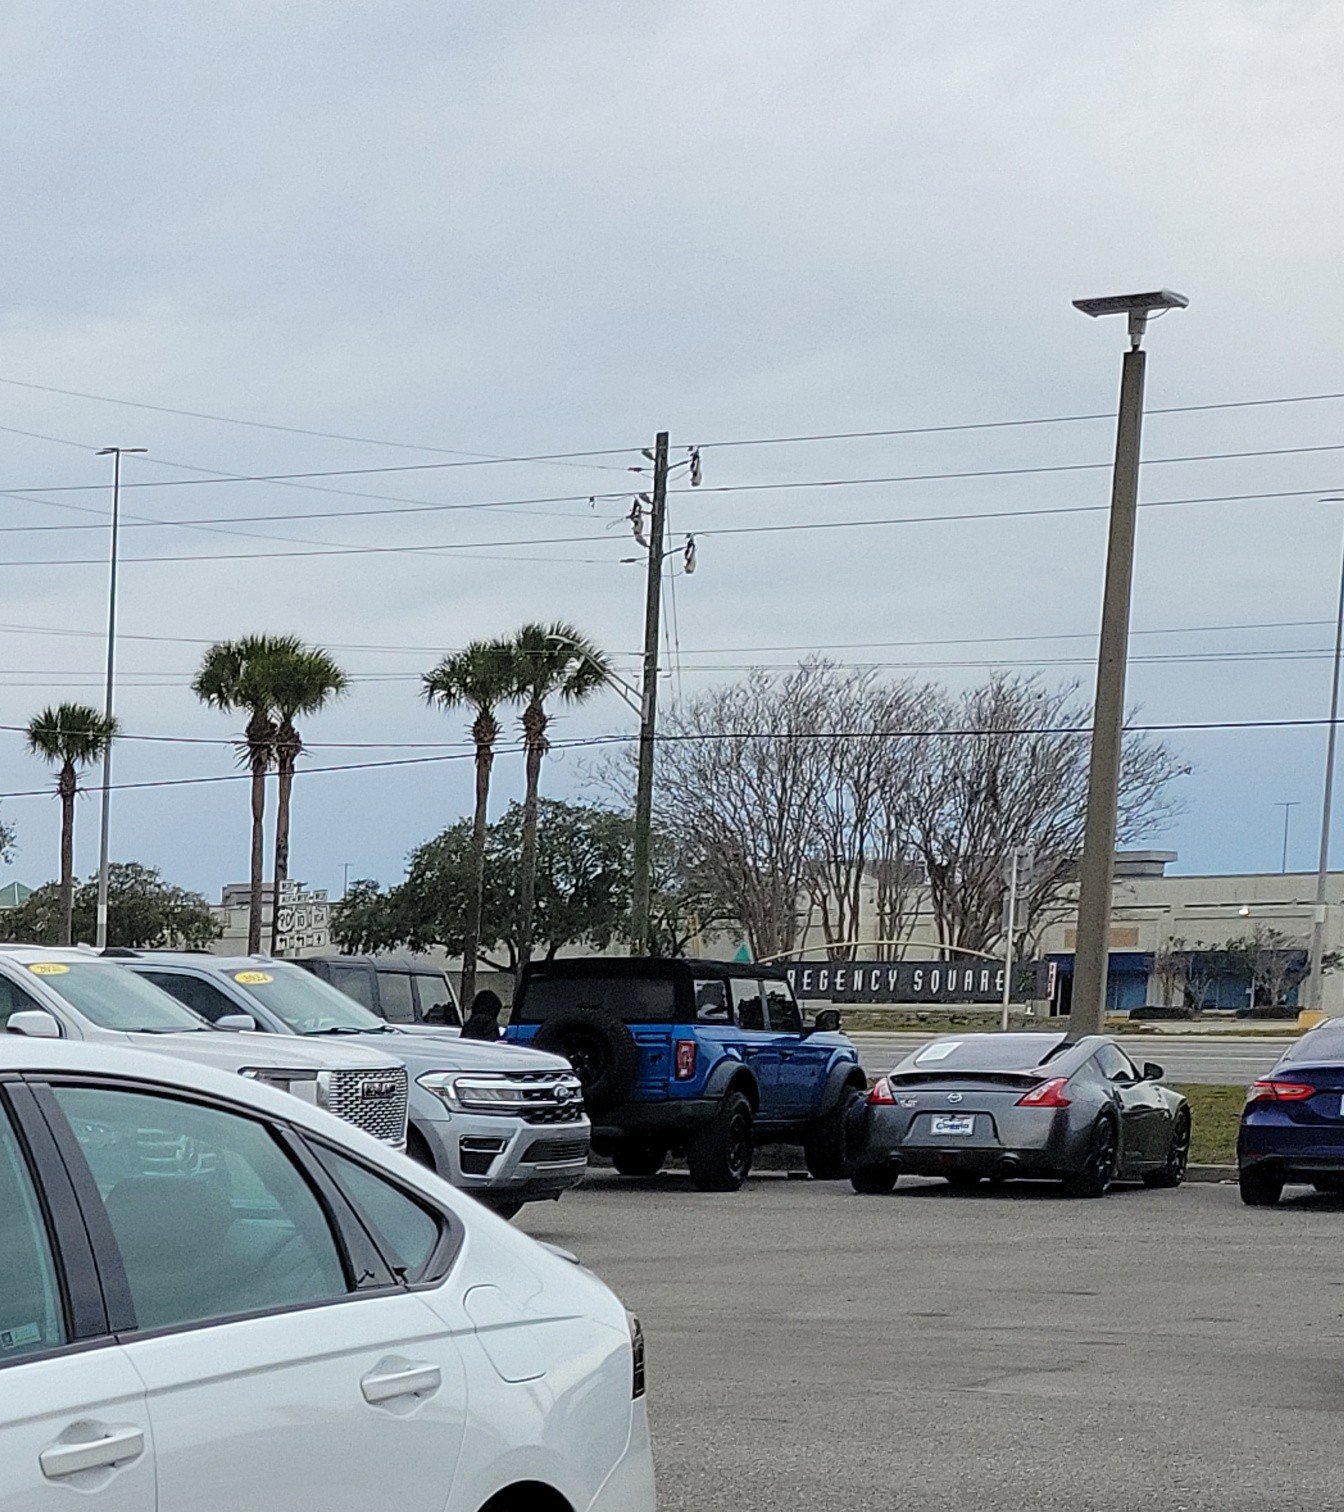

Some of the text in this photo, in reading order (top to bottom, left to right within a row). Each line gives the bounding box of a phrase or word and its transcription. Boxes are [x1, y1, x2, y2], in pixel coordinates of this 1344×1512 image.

[279, 911, 292, 928] 90
[786, 968, 1005, 994] REGENCY SQUARE
